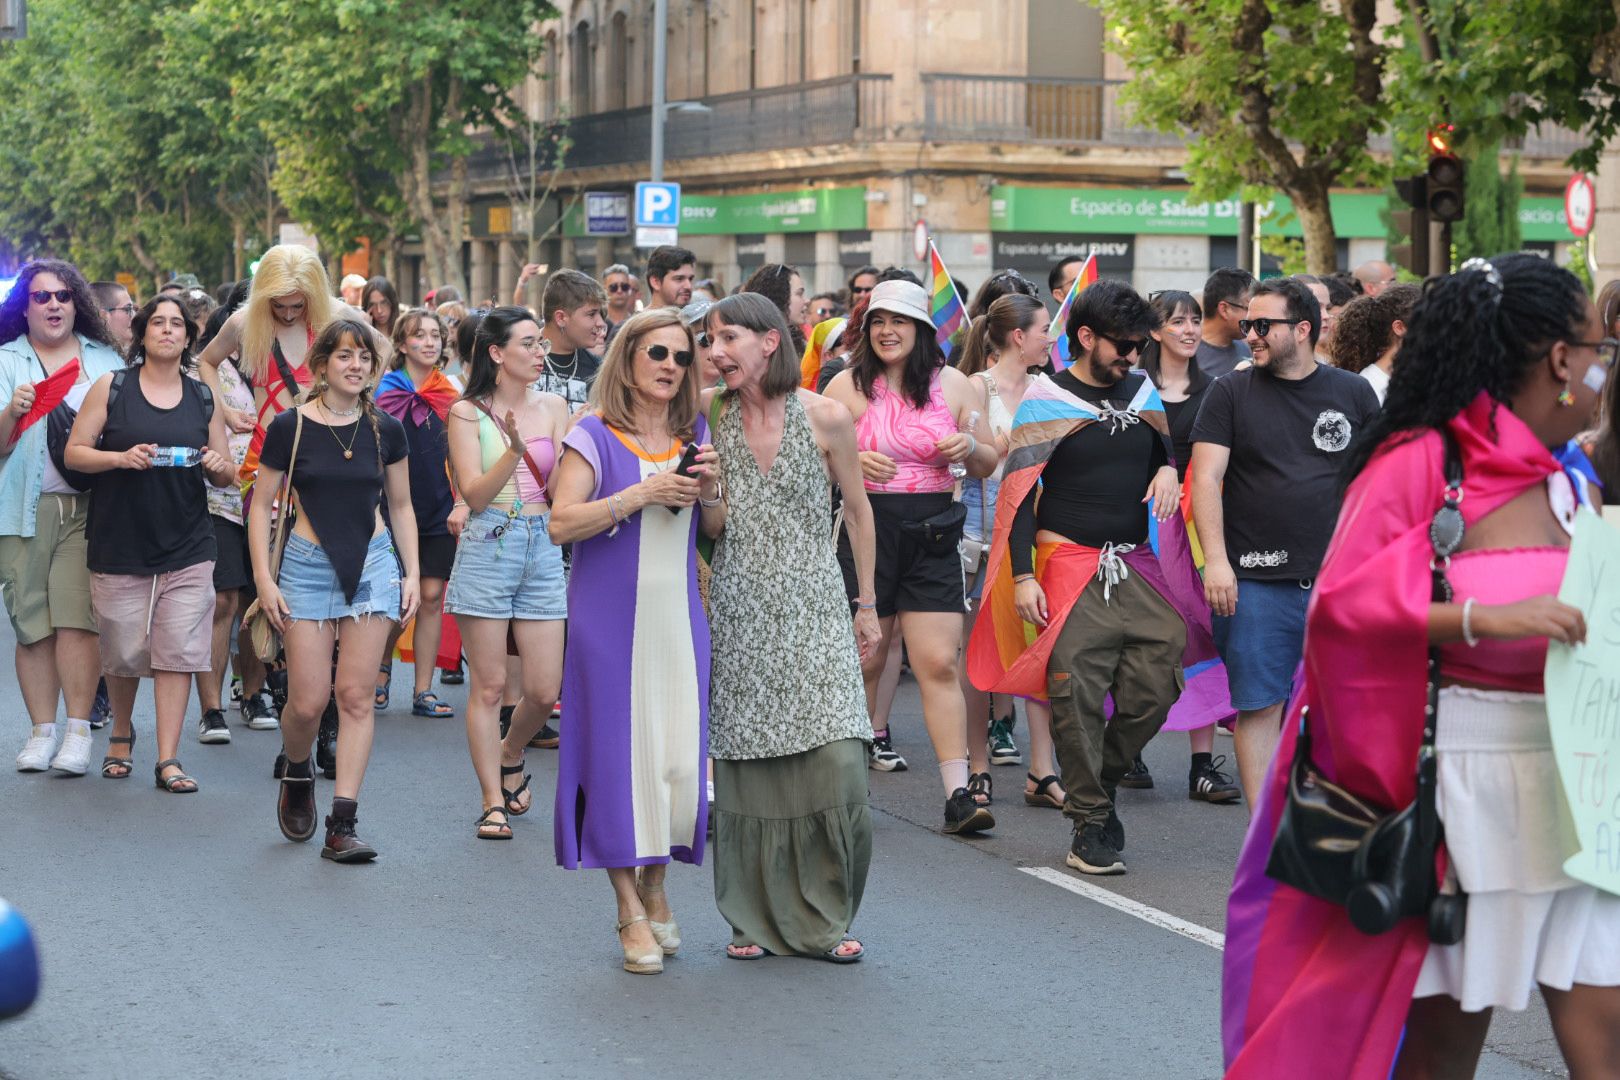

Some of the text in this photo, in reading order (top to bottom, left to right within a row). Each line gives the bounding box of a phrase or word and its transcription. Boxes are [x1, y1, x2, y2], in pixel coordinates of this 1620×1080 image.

[643, 187, 672, 222] P
[682, 206, 717, 220] DKV
[1070, 197, 1275, 219] Espacio de Salud DV
[998, 241, 1128, 257] Espacio de Salud DKV
[1587, 552, 1606, 619] Y
[1573, 749, 1608, 809] TÚ
[1595, 822, 1620, 873] A
